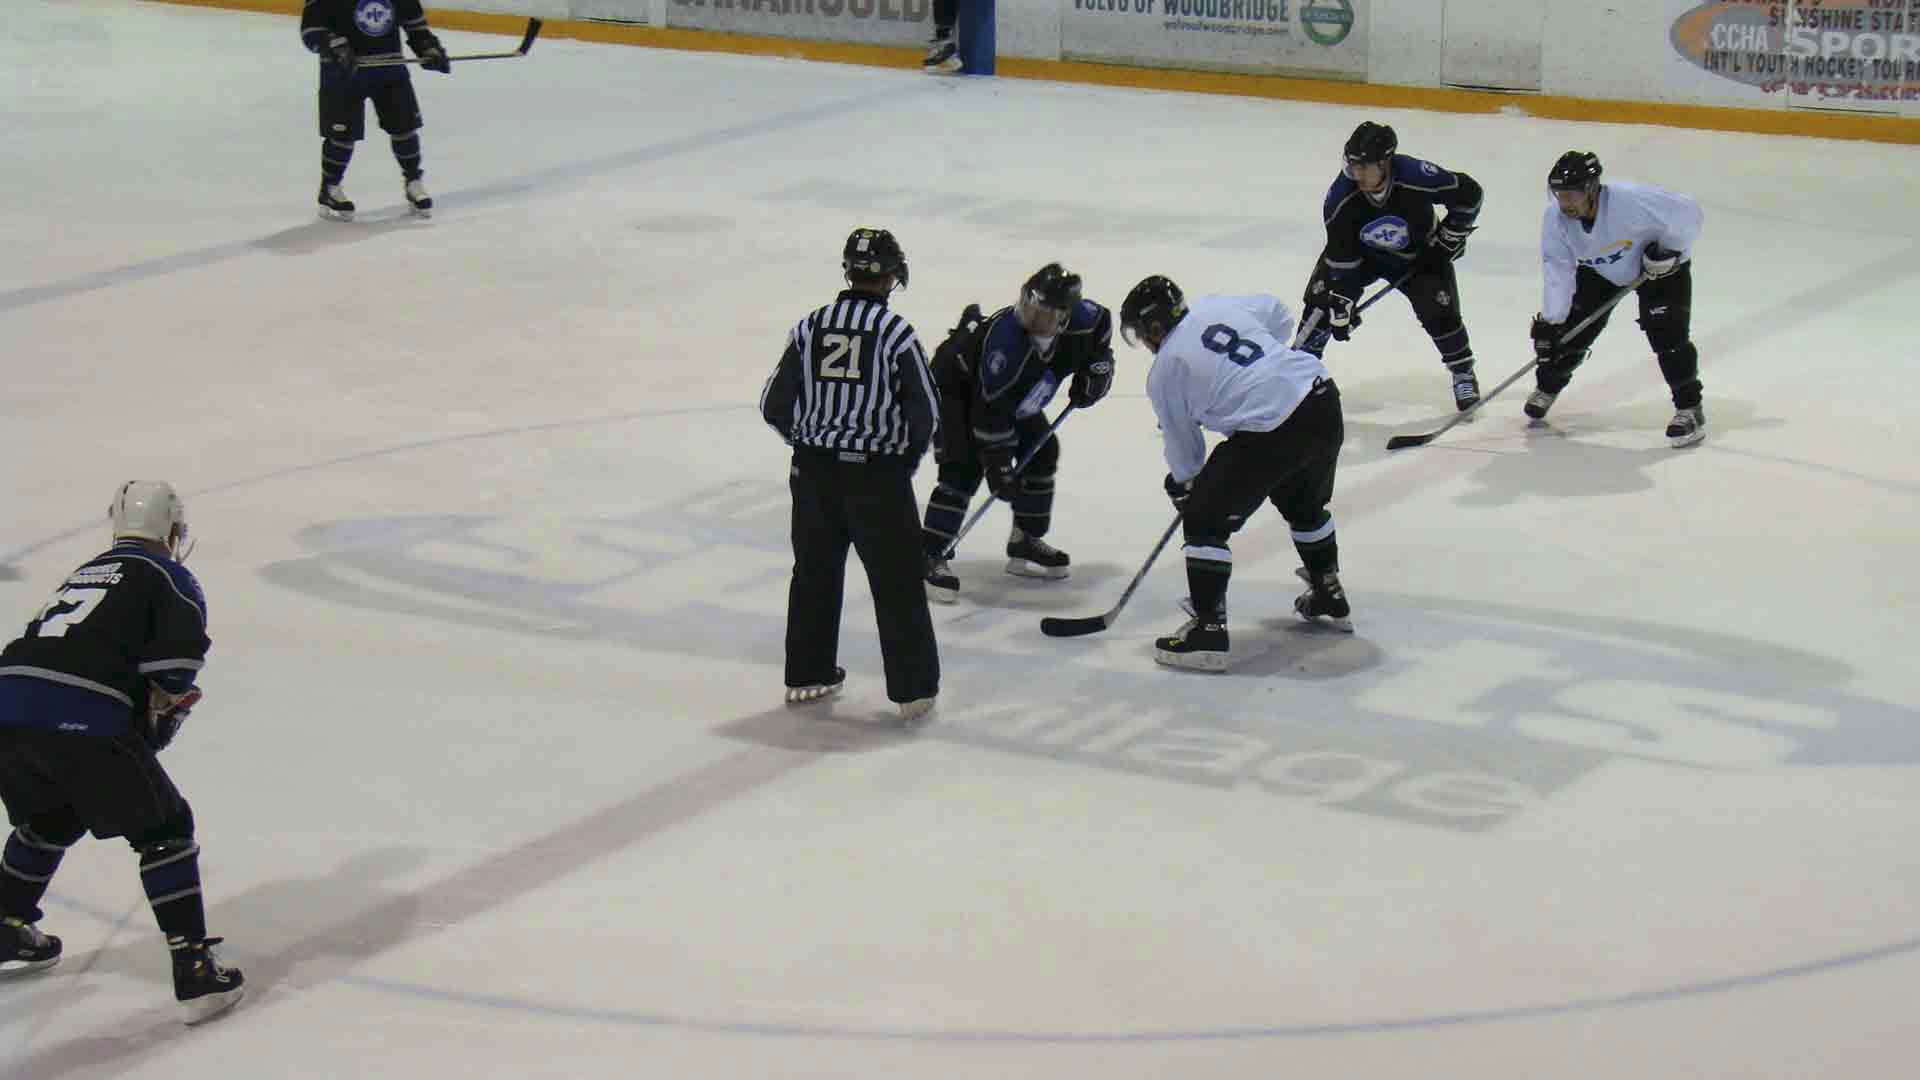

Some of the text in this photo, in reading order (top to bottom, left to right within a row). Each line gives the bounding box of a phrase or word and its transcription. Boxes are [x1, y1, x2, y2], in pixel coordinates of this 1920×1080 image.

[673, 0, 931, 22] AMOULD
[1163, 0, 1288, 21] WOODBRIDGE
[1711, 23, 1769, 50] CCHA
[1806, 56, 1867, 80] HOCKEY
[1872, 58, 1920, 80] TOUR
[819, 333, 862, 379] 21
[1200, 323, 1265, 367] 8
